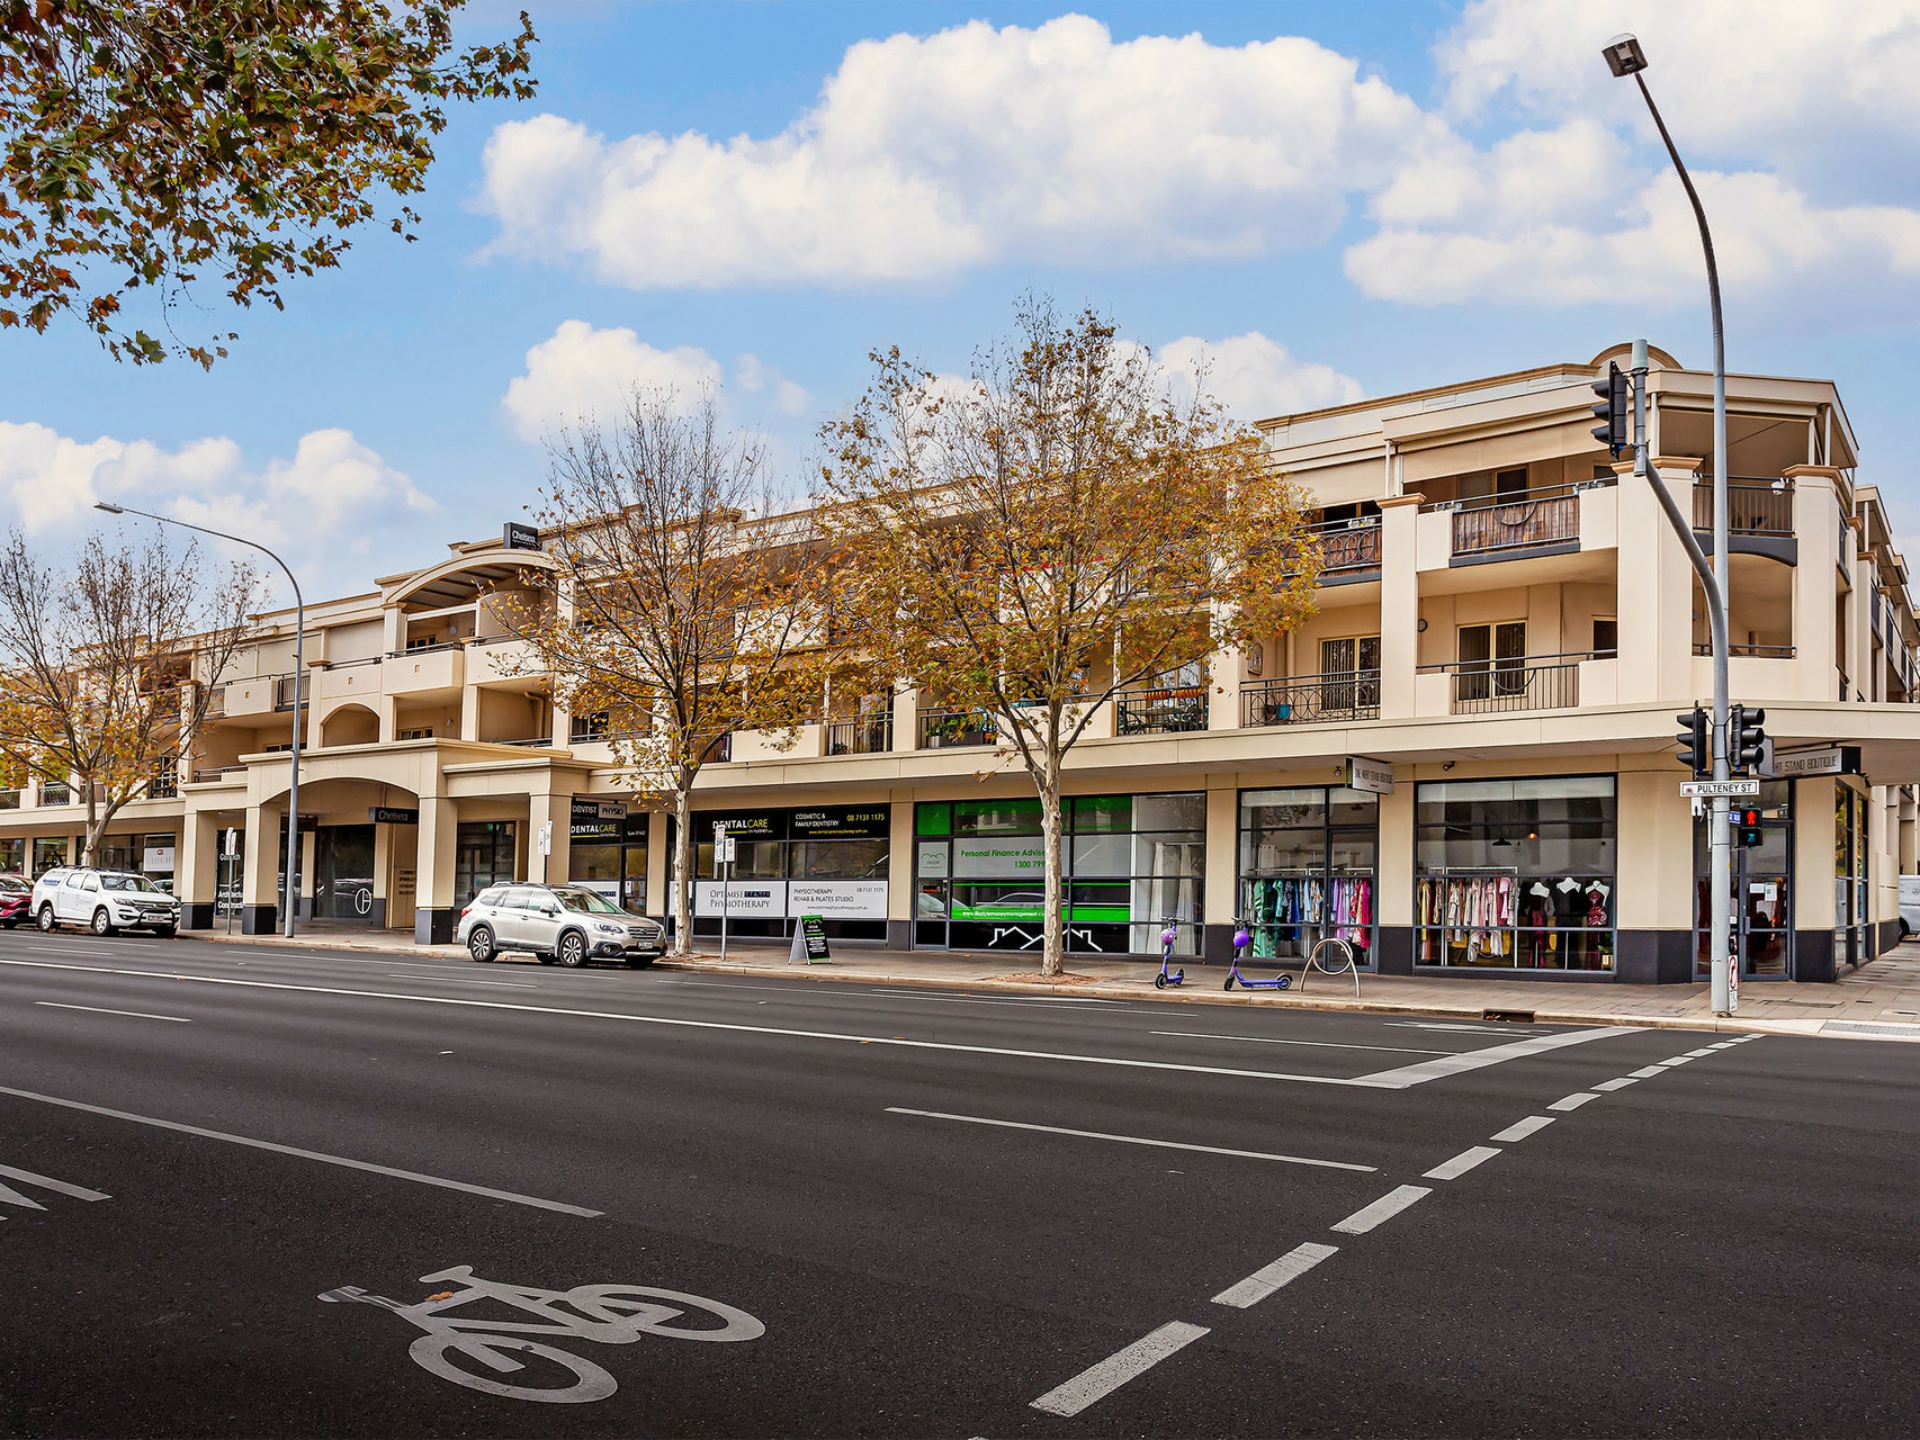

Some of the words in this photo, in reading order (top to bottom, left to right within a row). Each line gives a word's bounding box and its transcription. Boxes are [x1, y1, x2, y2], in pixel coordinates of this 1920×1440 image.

[511, 530, 536, 543] Chelsea
[1784, 759, 1805, 772] STAND
[1807, 755, 1837, 770] BOUTIQUE
[1696, 784, 1739, 794] PULTENEY
[1740, 783, 1752, 793] ST
[572, 805, 597, 814] DENTIST
[601, 807, 624, 816] PHYSIO
[378, 809, 408, 821] Chelsea
[846, 814, 855, 822] 08
[855, 813, 869, 821] 7131
[871, 813, 885, 821] 1175
[570, 823, 616, 834] DENTALCARE
[712, 818, 768, 830] DENTALCARE
[961, 849, 990, 858] Personal
[991, 849, 1020, 857] Finance
[1014, 860, 1031, 868] 1300
[709, 889, 744, 899] OPTMISE
[709, 899, 771, 908] PHYIOTHERAPY
